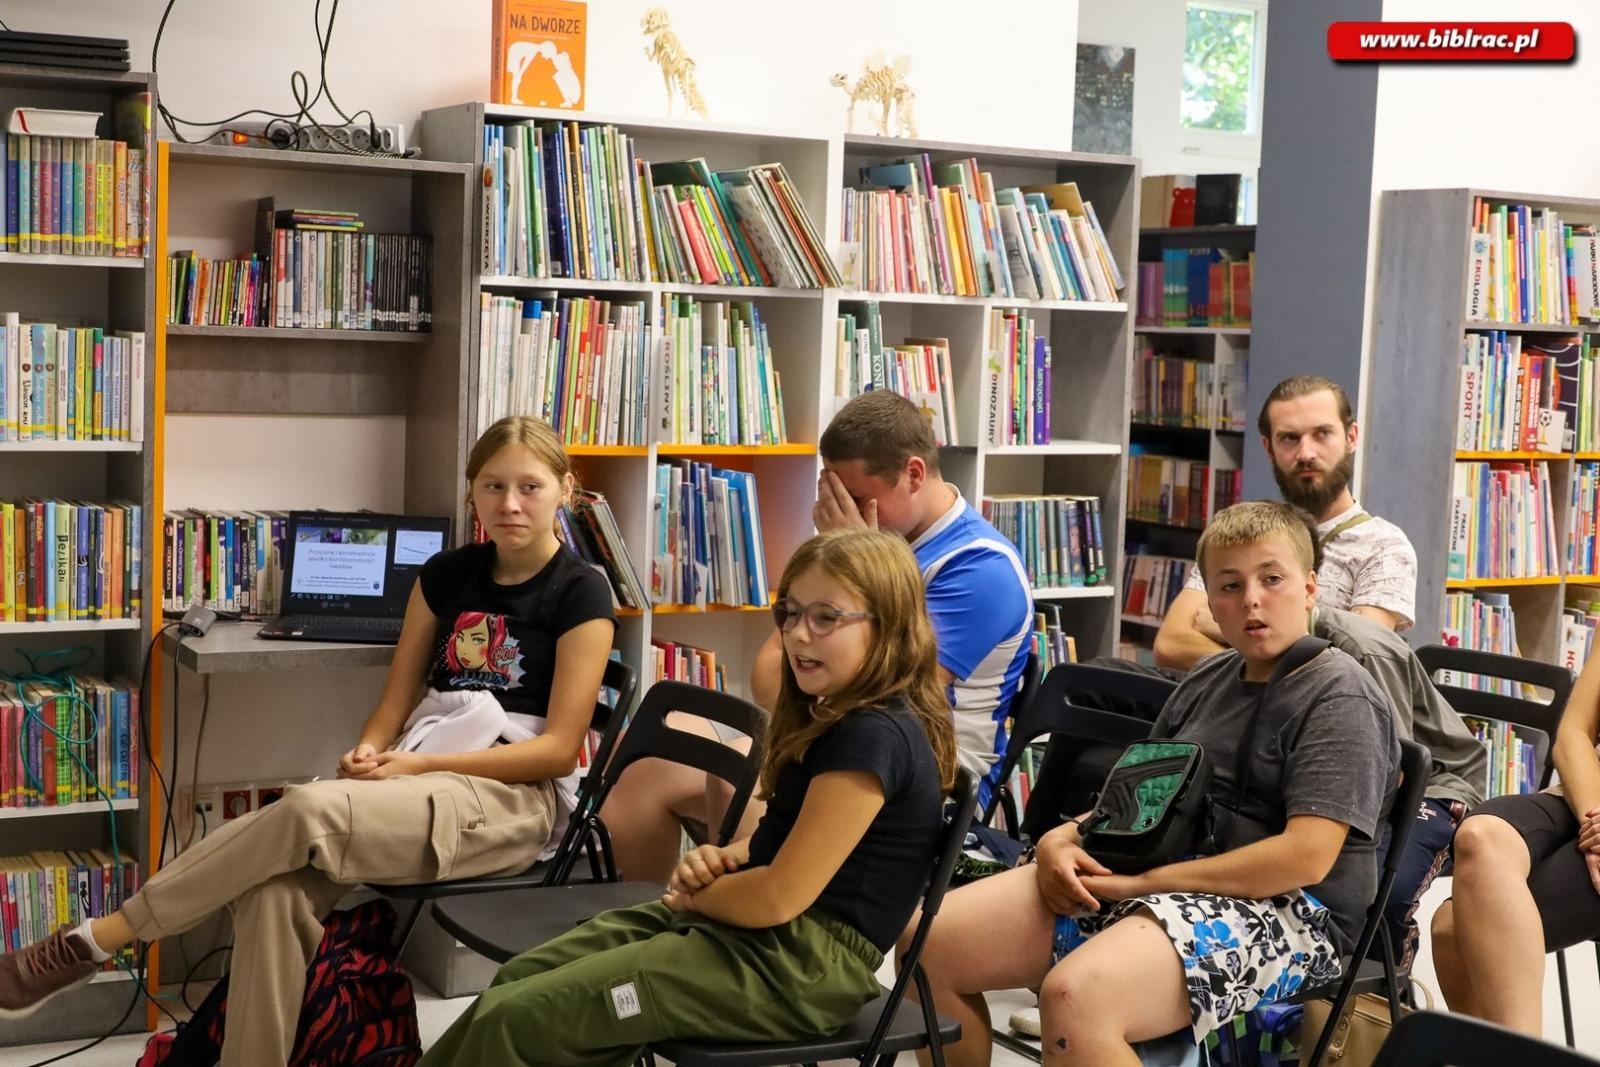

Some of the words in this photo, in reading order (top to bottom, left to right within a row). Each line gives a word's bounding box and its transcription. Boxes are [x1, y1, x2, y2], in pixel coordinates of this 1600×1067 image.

[509, 13, 527, 30] NA
[531, 15, 581, 34] DWORZE
[1589, 238, 1597, 262] PARKI
[1472, 259, 1482, 316] EKOLOGIA
[1590, 262, 1599, 308] NARODOWE
[872, 355, 883, 391] KONI
[1463, 371, 1475, 421] SPORT
[988, 374, 998, 444] DINOZAURY
[1452, 499, 1460, 551] PLASTYCZNE
